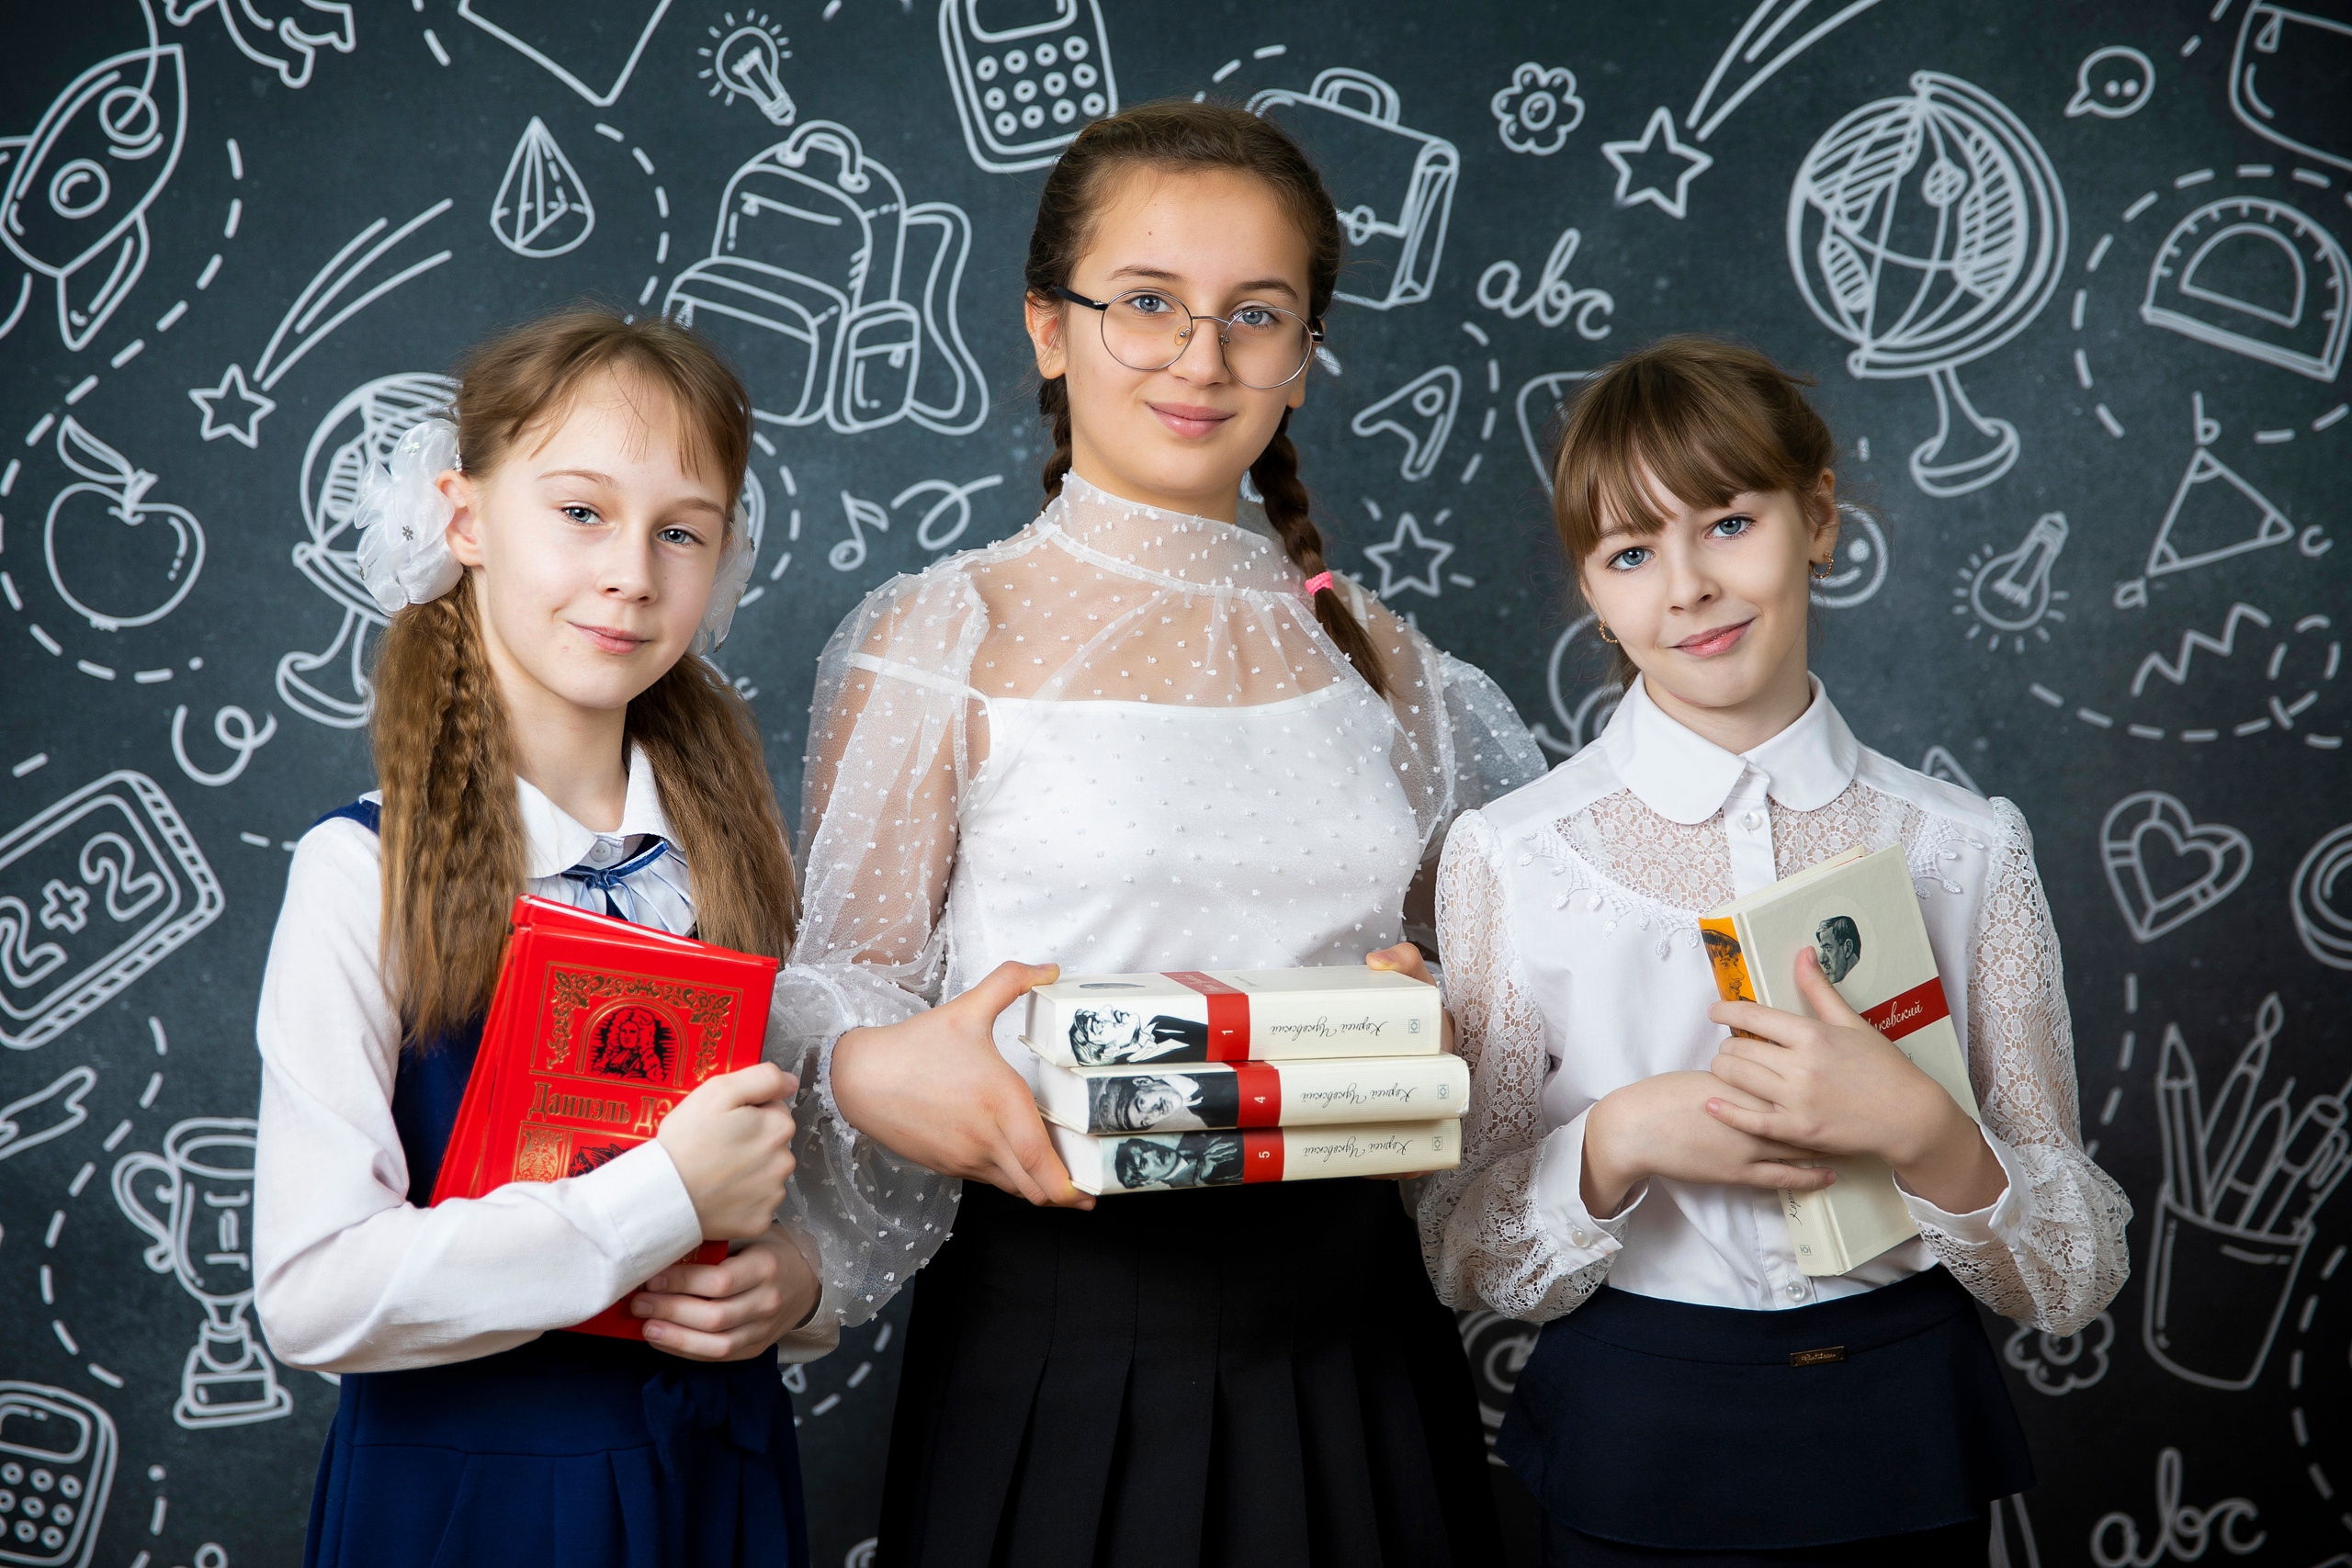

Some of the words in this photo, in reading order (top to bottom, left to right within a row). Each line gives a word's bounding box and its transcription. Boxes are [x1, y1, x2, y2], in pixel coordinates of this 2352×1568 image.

[1476, 229, 1614, 340] abc
[2192, 391, 2221, 446] b
[2300, 525, 2334, 558] c
[2113, 576, 2148, 608] a
[1270, 1016, 1338, 1041] Чуковский
[1340, 1016, 1388, 1036] Корней
[1868, 1000, 1923, 1032] ковский
[1254, 1096, 1266, 1104] 4
[1301, 1082, 1367, 1109] Чуковский
[1370, 1082, 1418, 1102] Корней
[527, 1082, 630, 1124] Даниэль
[634, 1096, 673, 1135] ДЭ
[1303, 1135, 1366, 1162] Чуковский
[1368, 1134, 1413, 1156] Корней
[2089, 1446, 2267, 1568] abc
